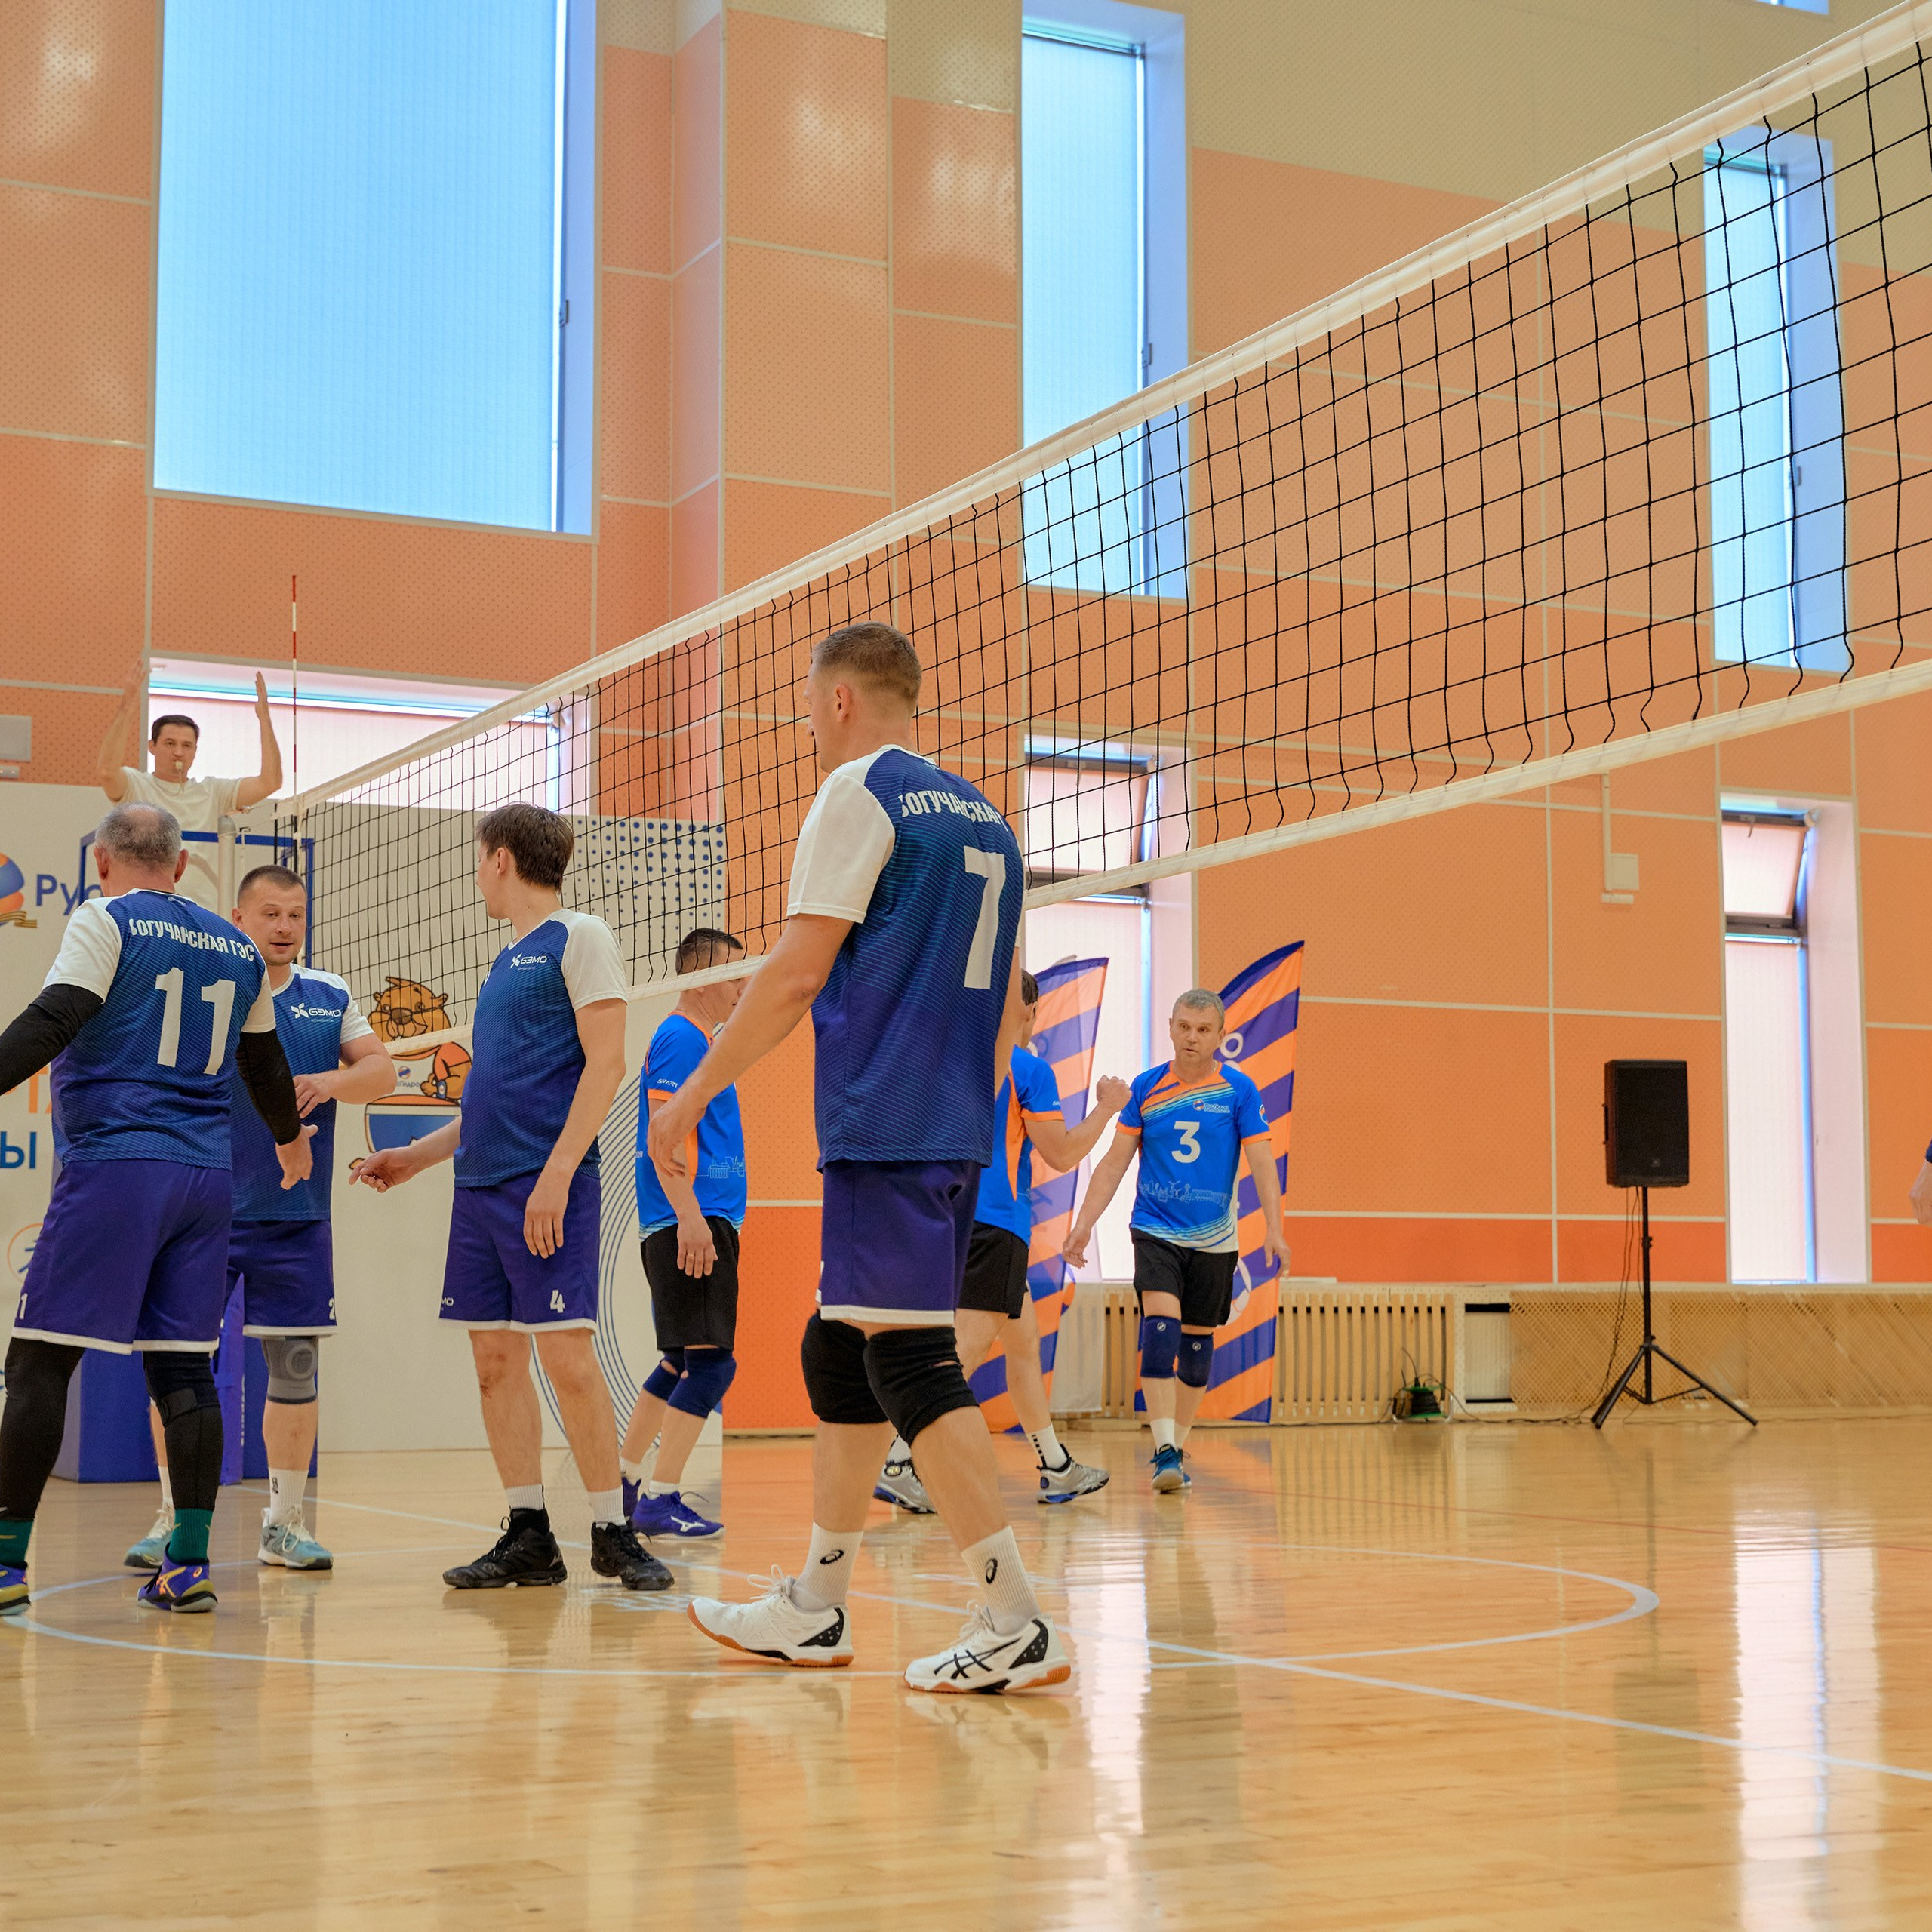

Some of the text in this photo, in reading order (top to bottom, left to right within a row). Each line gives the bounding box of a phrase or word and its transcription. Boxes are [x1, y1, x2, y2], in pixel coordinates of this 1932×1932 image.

[964, 845, 1006, 989] 7
[229, 939, 255, 962] ГЭС
[155, 967, 236, 1075] 11
[1171, 1121, 1201, 1163] 3
[550, 1289, 565, 1313] 4
